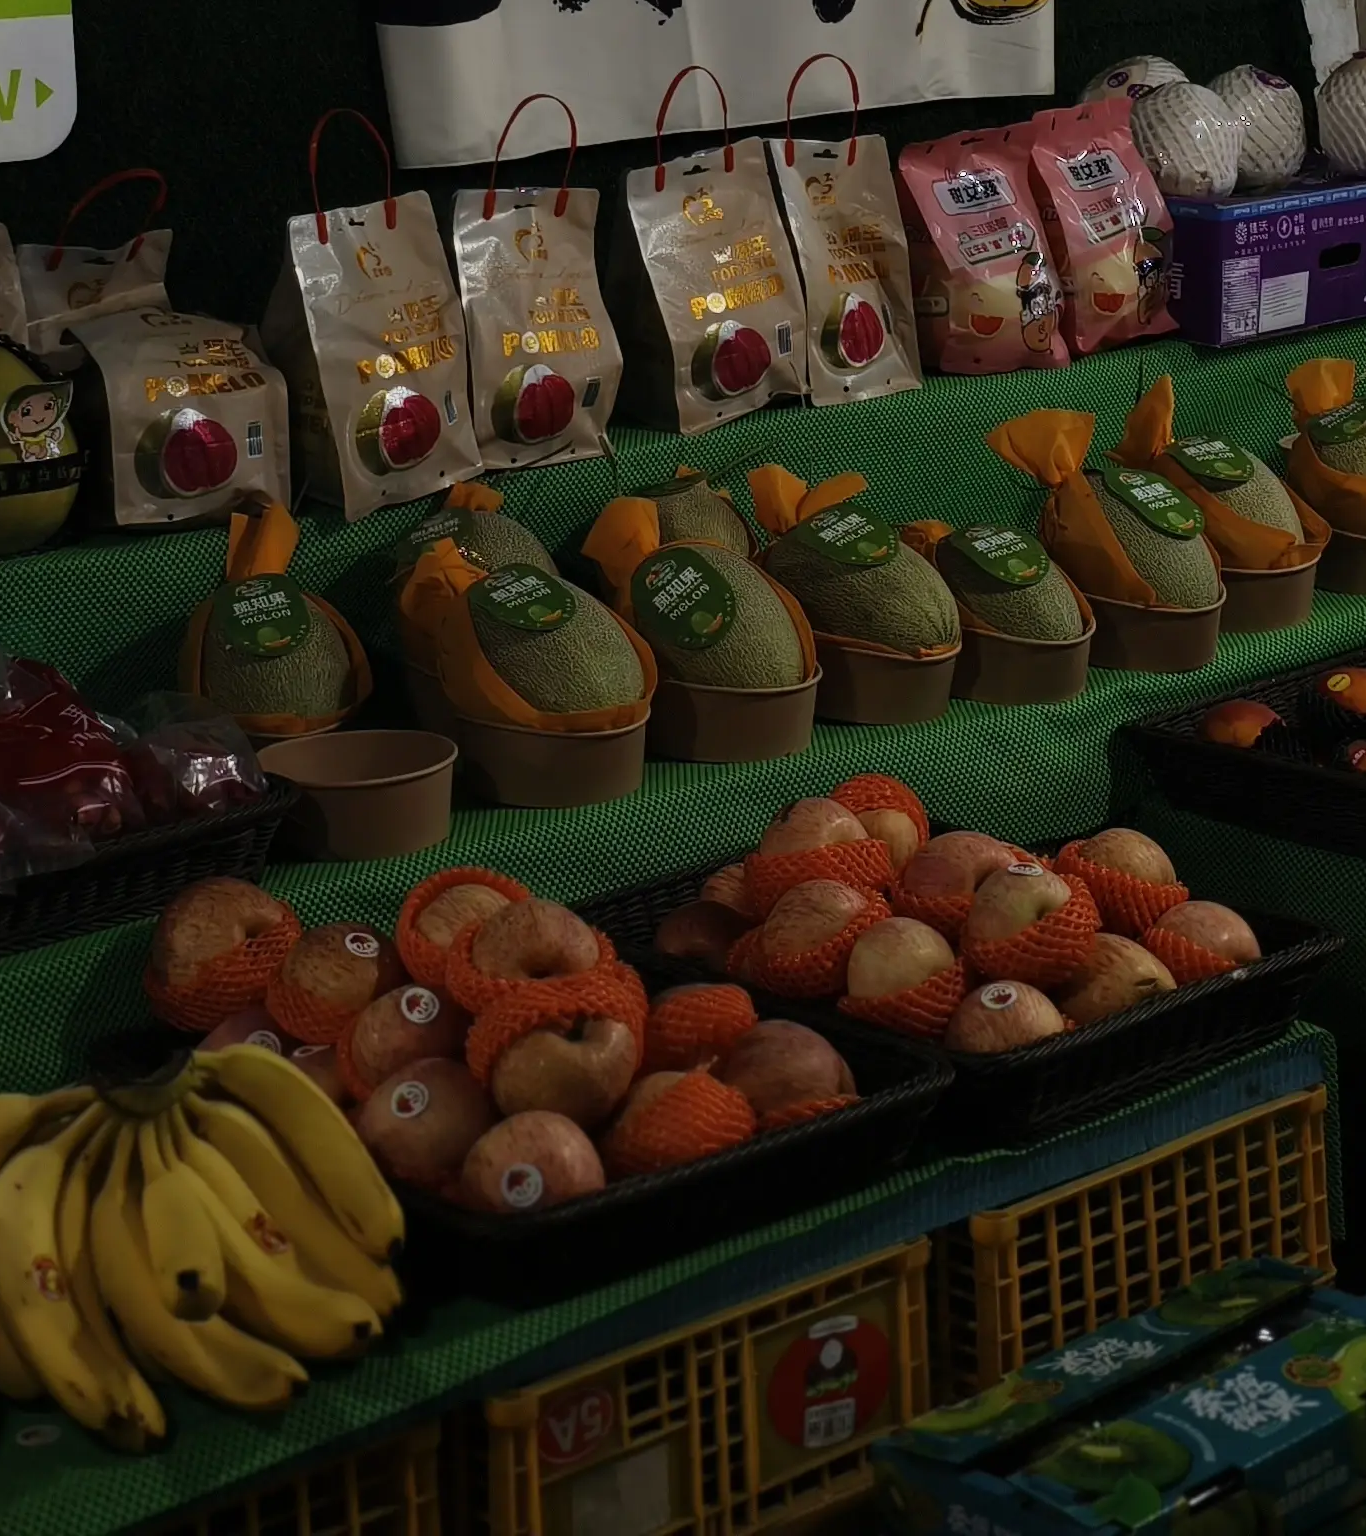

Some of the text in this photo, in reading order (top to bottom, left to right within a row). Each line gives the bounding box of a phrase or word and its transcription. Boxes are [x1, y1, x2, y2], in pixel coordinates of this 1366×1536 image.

[506, 587, 553, 609] MELON
[668, 582, 711, 621] MELON
[241, 608, 292, 626] MELON
[548, 1395, 603, 1454] 5A
